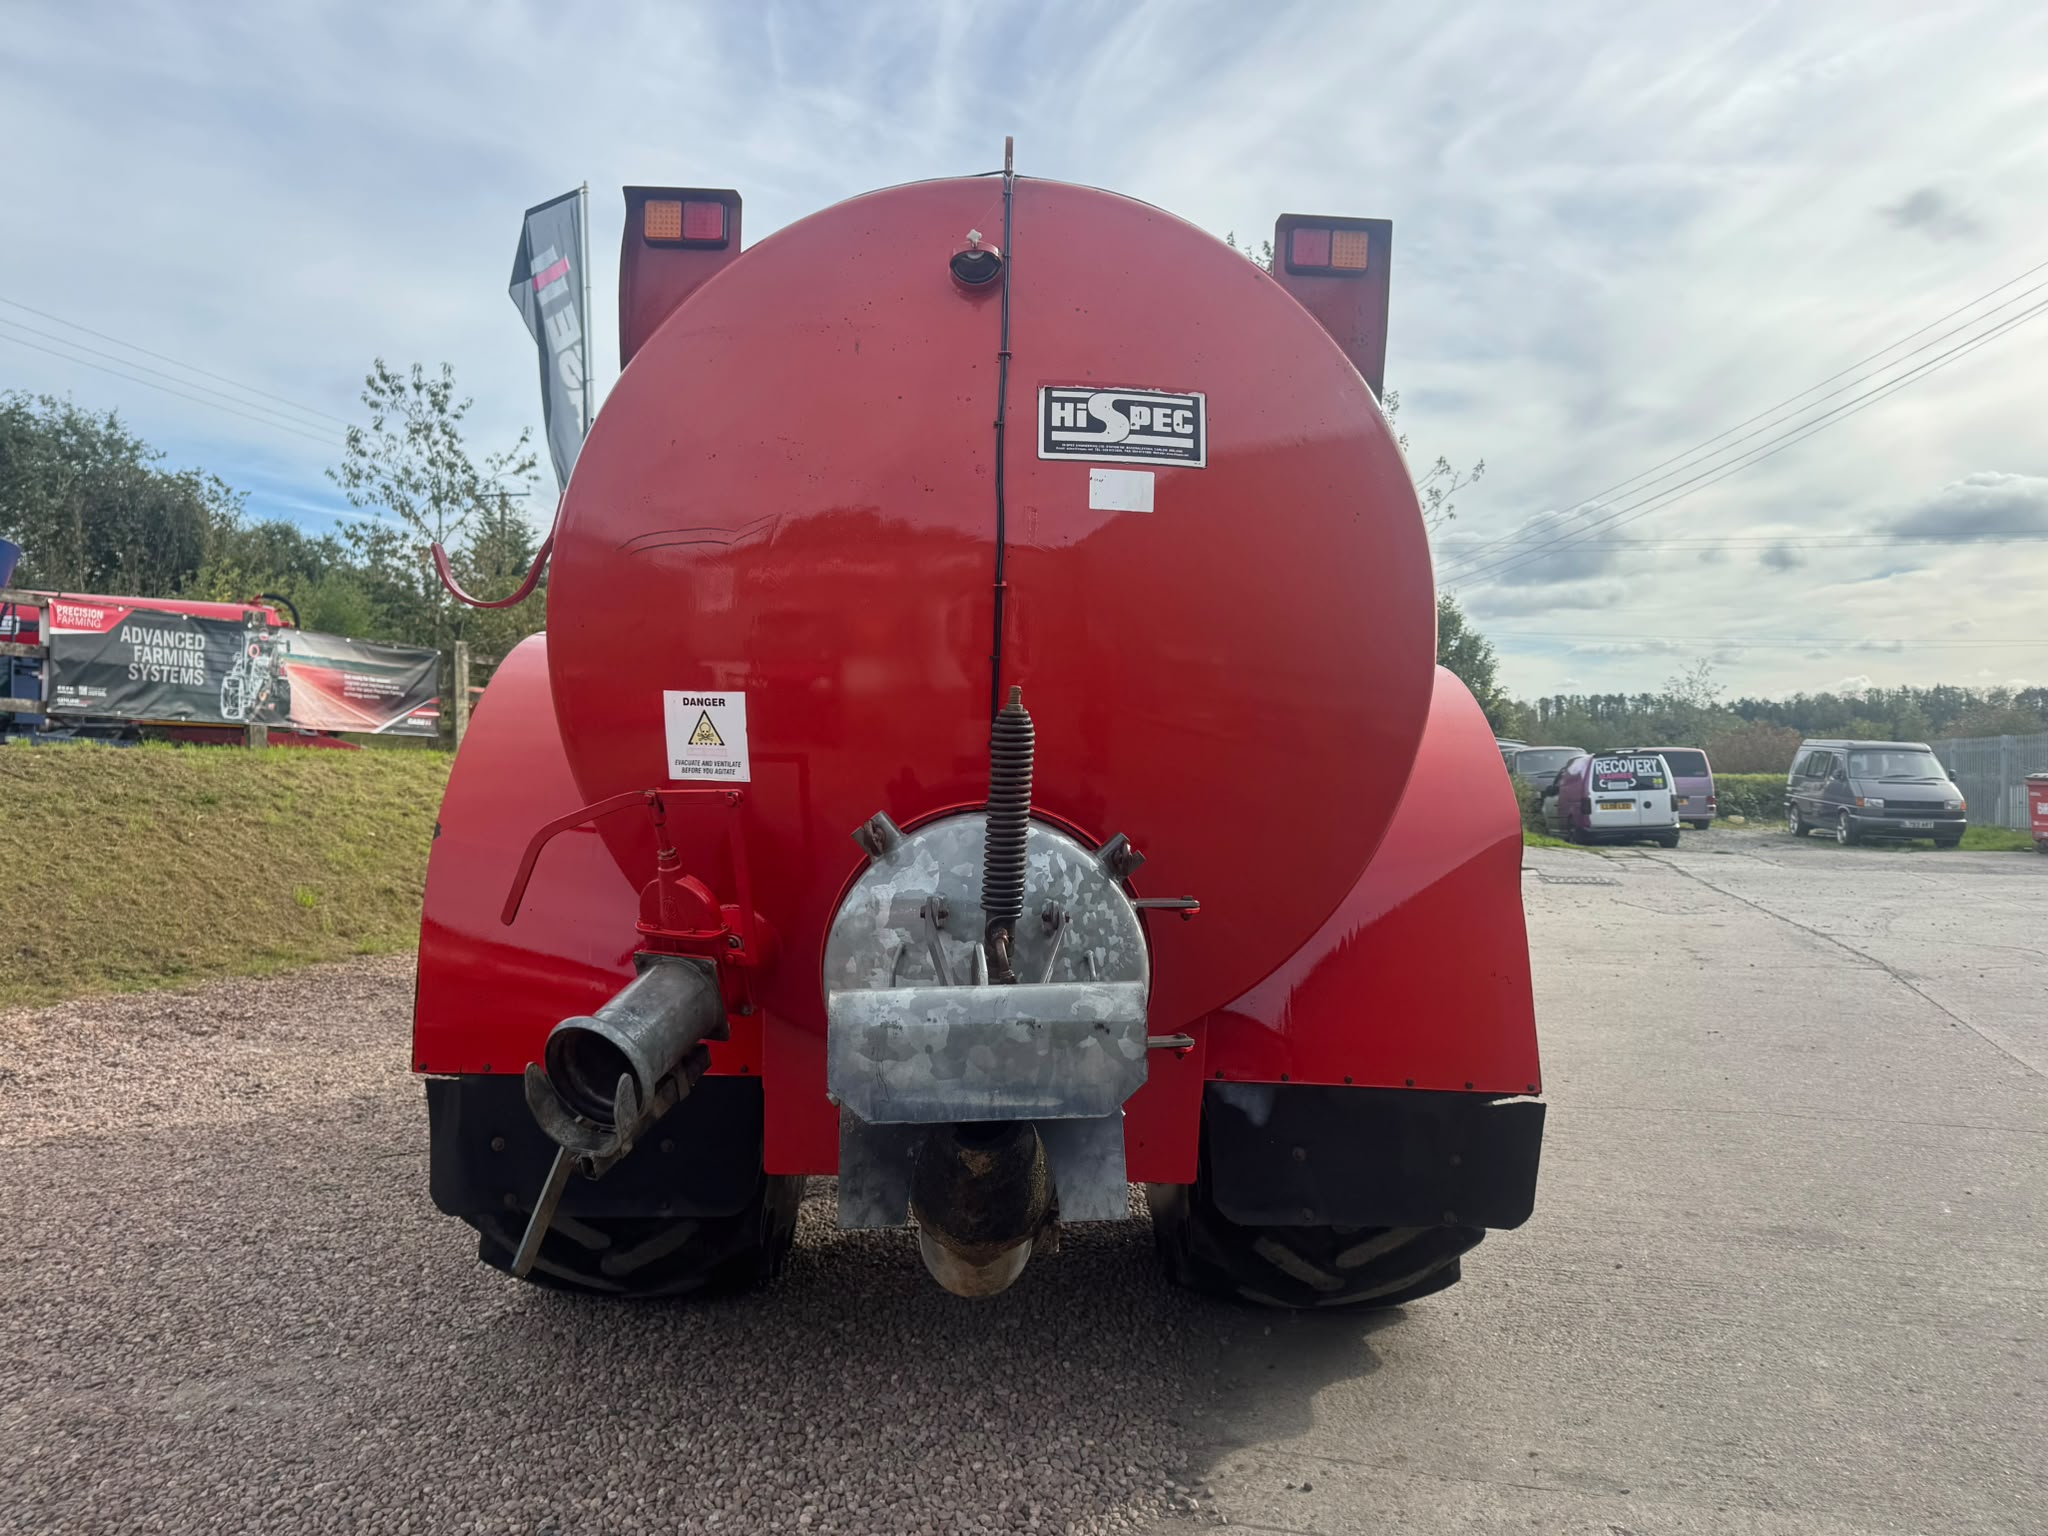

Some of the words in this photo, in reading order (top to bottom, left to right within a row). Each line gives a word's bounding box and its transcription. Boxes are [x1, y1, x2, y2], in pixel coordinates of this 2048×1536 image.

[56, 604, 104, 620] PRECISION
[56, 614, 102, 628] FARMING
[120, 625, 205, 650] ADVANCED
[134, 645, 205, 668] FARMING
[128, 663, 205, 686] SYSTEMS
[682, 697, 726, 707] DANGER
[675, 759, 700, 767] EVACUATE
[714, 760, 742, 768] VENTILATE
[703, 767, 713, 775] YOU
[1595, 759, 1657, 774] RECOVERY
